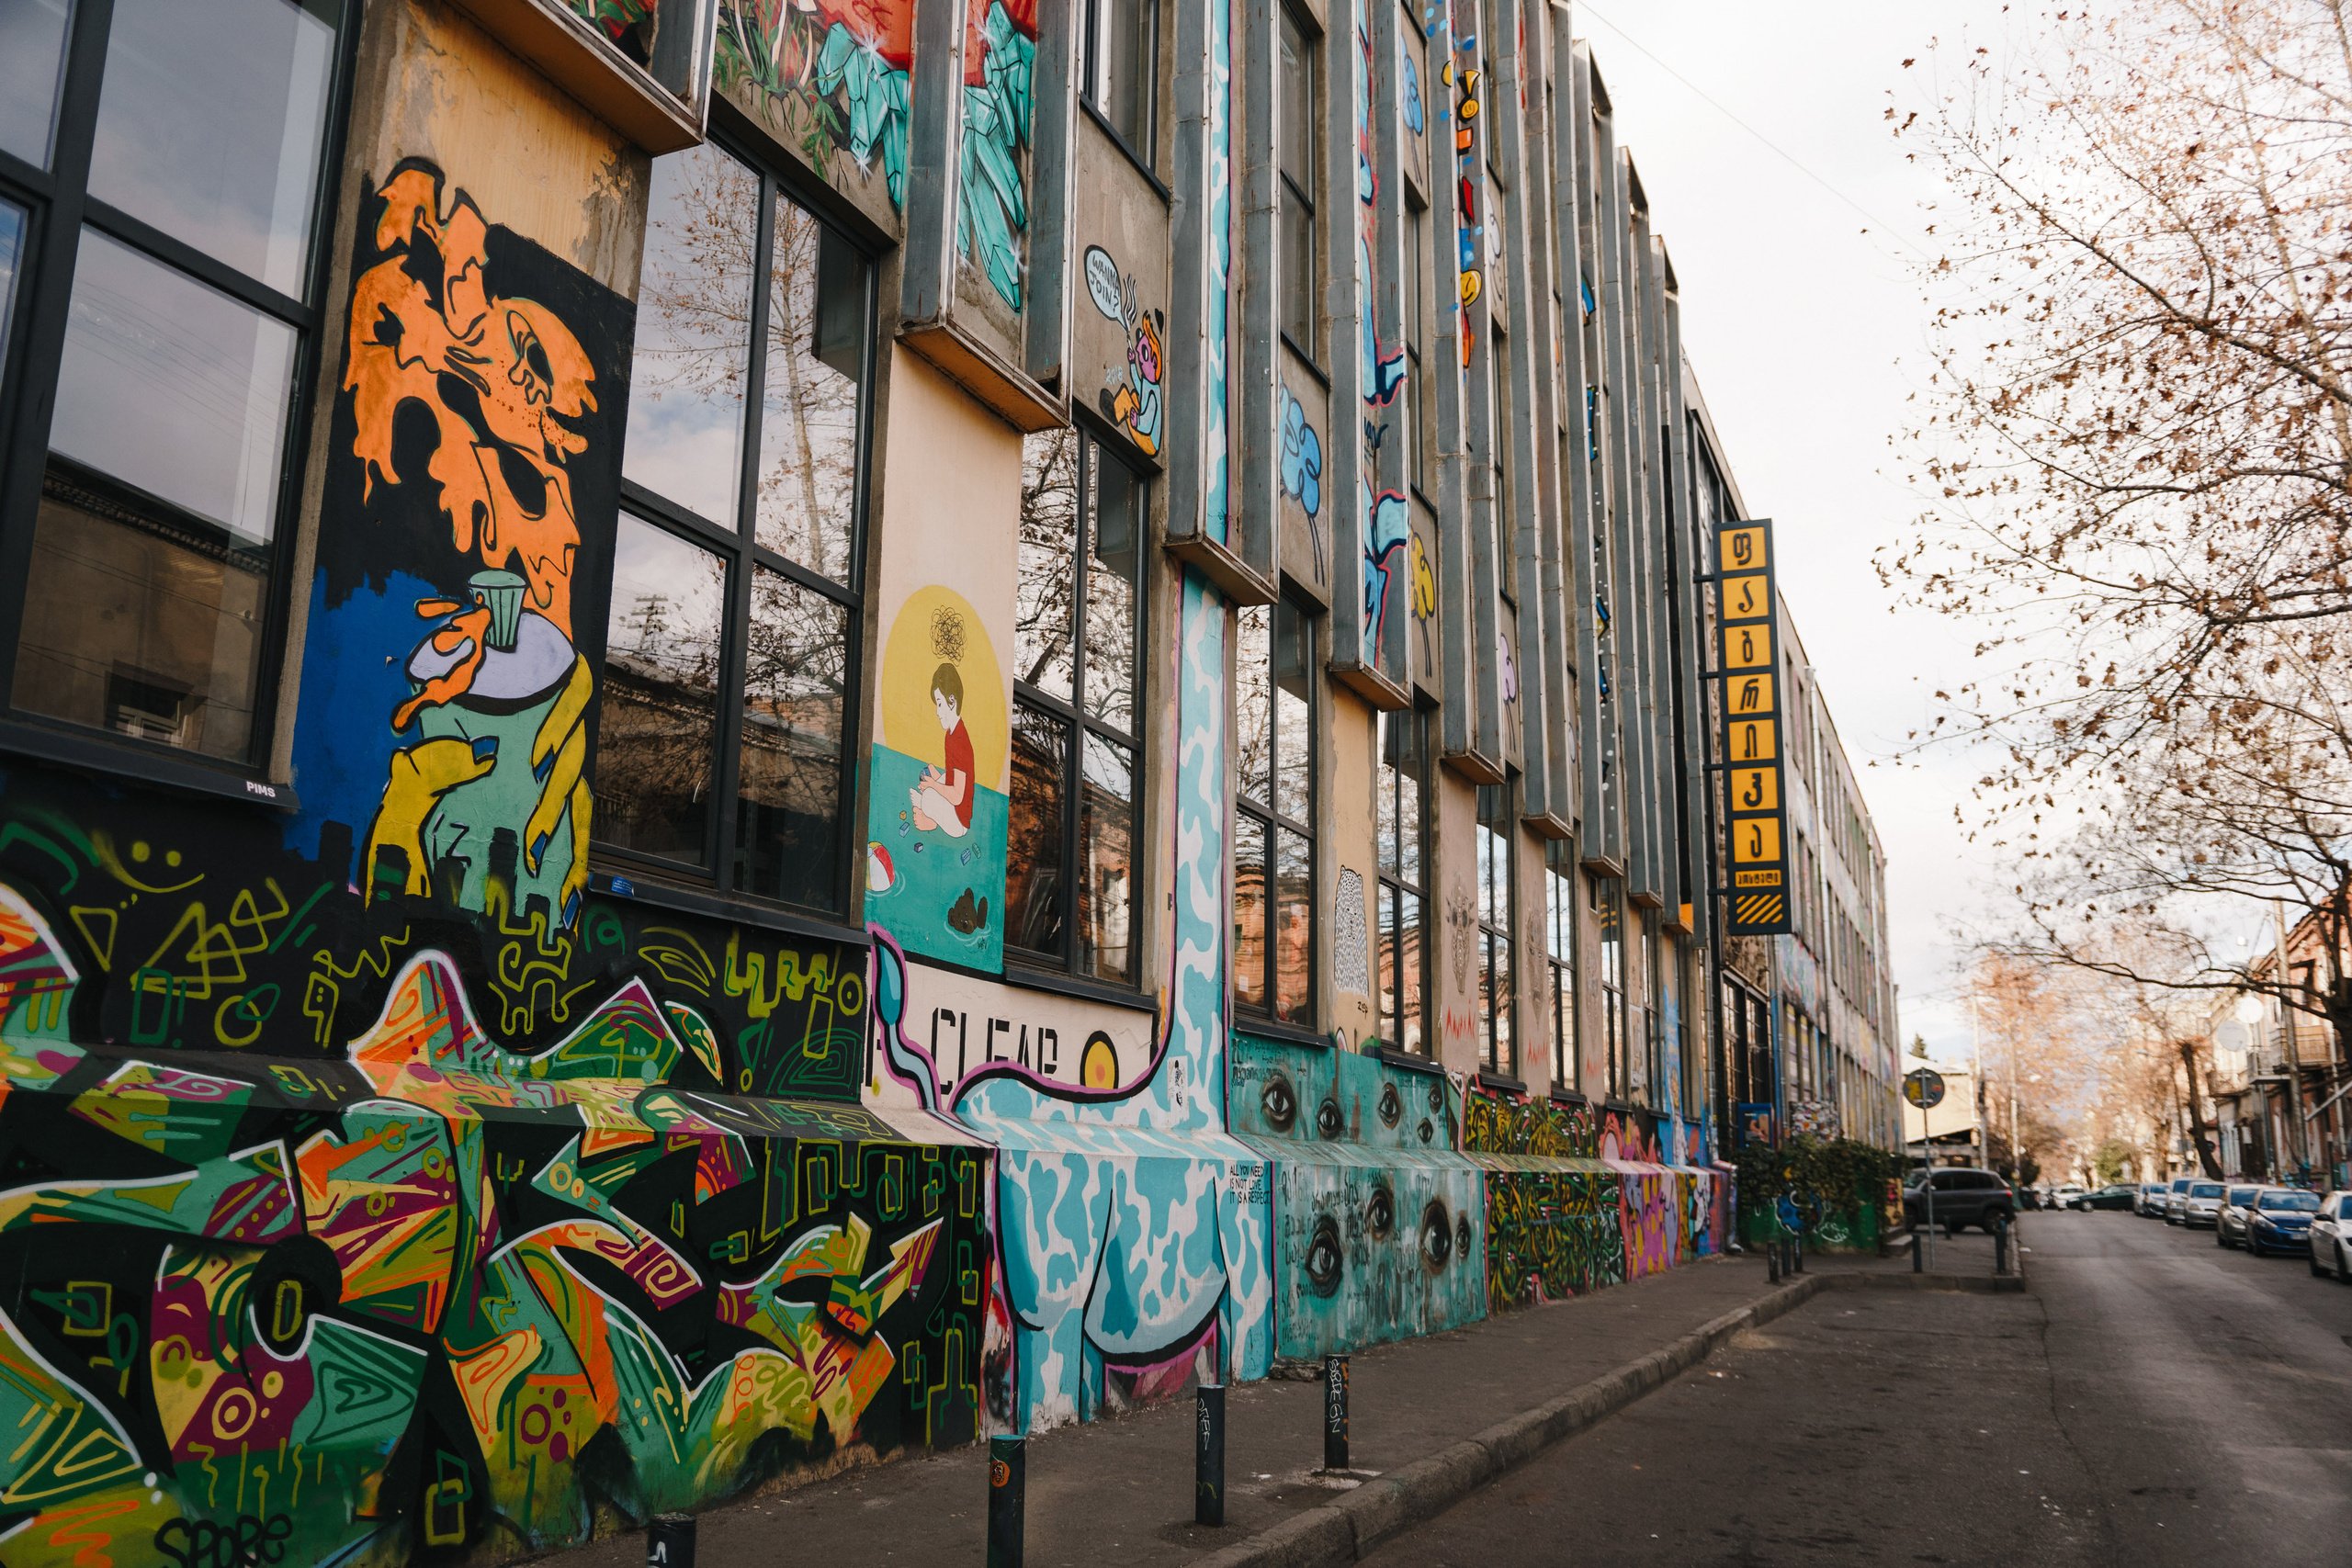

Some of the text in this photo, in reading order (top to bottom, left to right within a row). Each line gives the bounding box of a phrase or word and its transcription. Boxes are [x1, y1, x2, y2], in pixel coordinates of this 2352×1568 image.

[1091, 254, 1120, 297] WANNA
[1105, 365, 1124, 385] 2018
[1733, 532, 1762, 858] ფაბრიკა
[246, 781, 276, 797] PIMS
[1229, 1164, 1264, 1178] ALL YOU NEED
[1229, 1177, 1262, 1191] IS NOT LOVE
[1229, 1190, 1236, 1205] IT
[1237, 1190, 1243, 1205] IS
